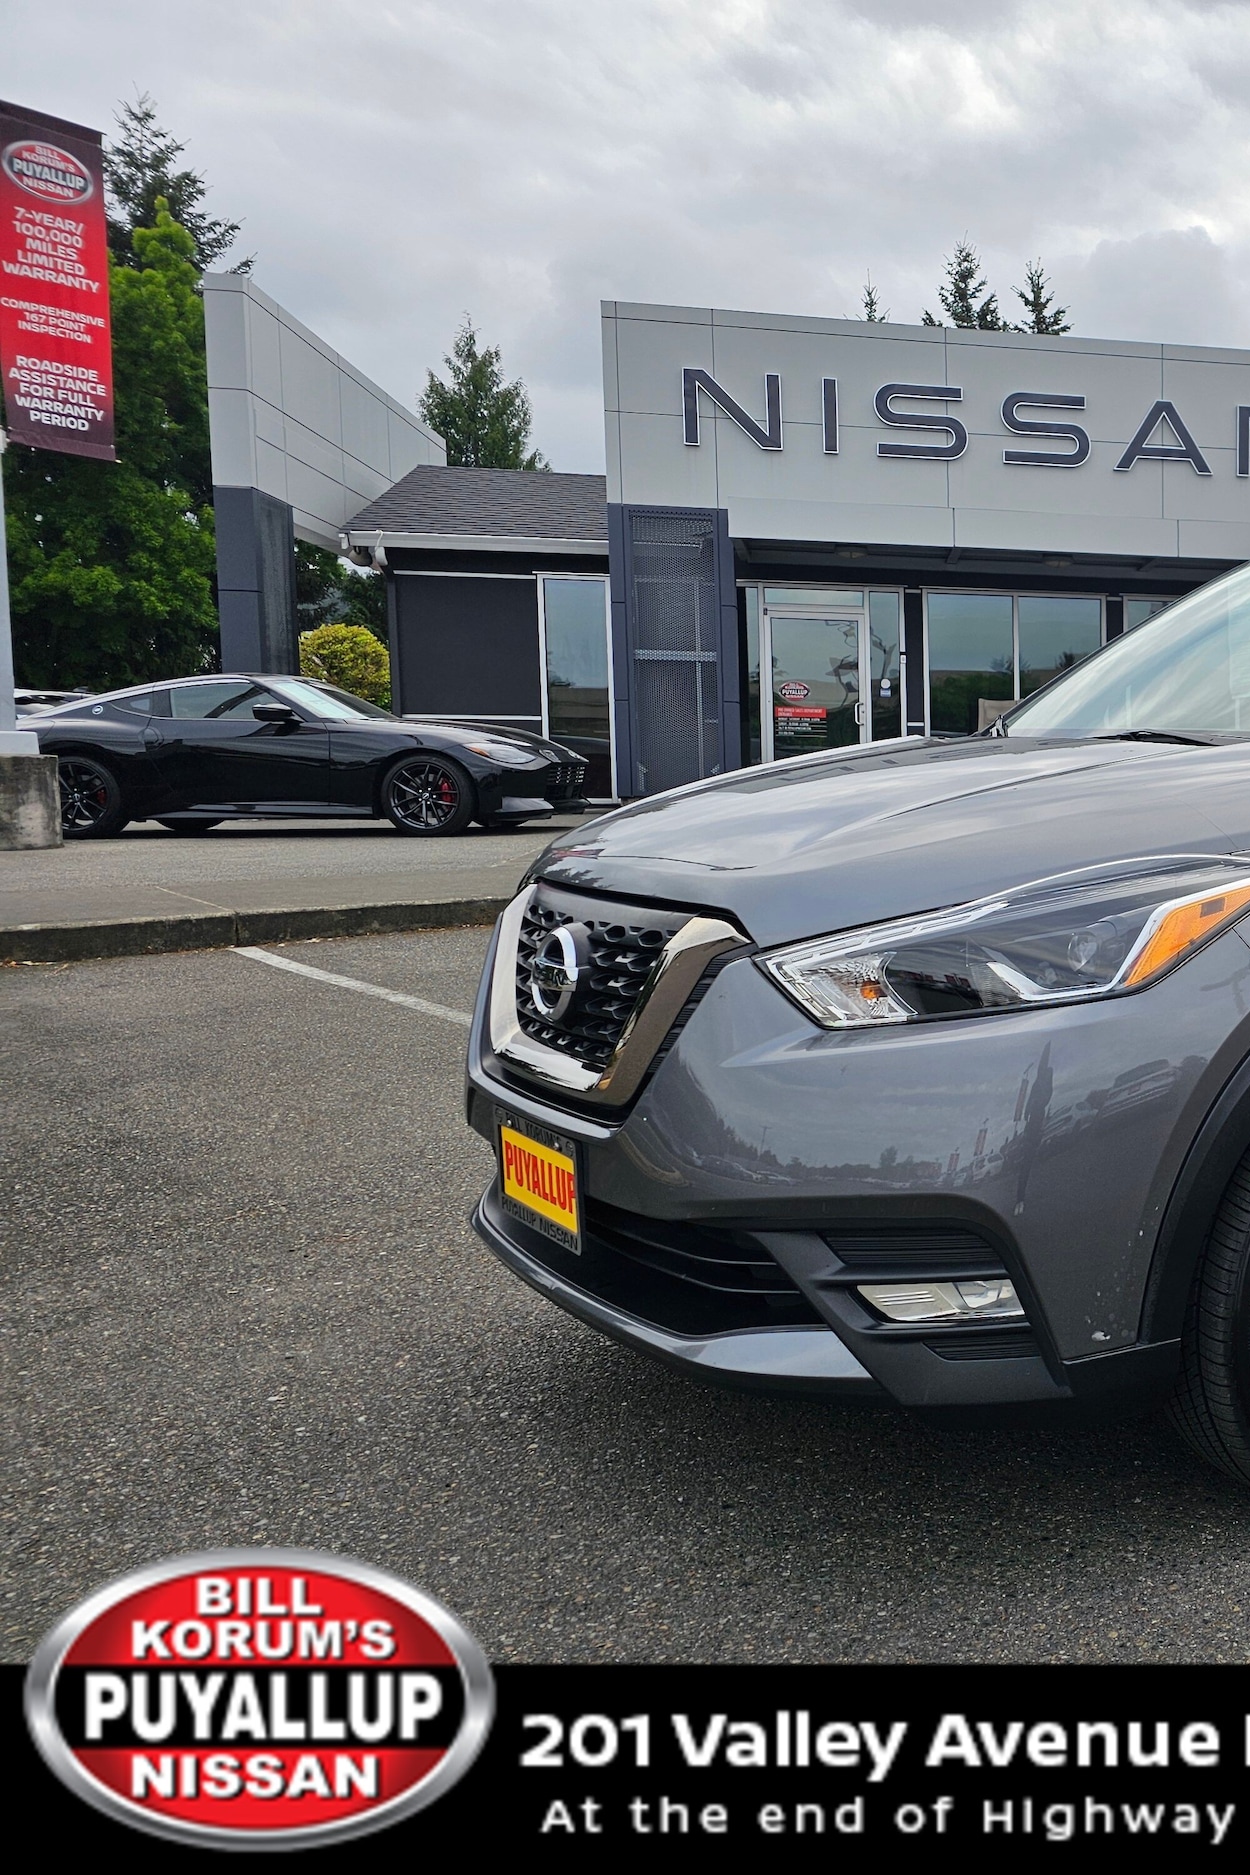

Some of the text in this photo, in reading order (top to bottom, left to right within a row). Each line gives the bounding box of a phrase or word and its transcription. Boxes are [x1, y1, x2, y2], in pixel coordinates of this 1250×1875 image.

[22, 151, 75, 171] KORUM'S
[35, 145, 61, 160] BILL
[13, 158, 85, 190] PUYALLUP
[23, 176, 74, 198] NISSAN
[14, 206, 84, 235] 7-YEAR/
[12, 221, 83, 248] 100,000
[26, 238, 78, 260] MILES
[2, 260, 100, 293] WARRANTY
[17, 250, 85, 276] LIMITED
[0, 297, 105, 328] COMPREHENSIVE
[24, 311, 86, 332] 167 POINT
[18, 320, 92, 344] INSPECTION
[9, 367, 106, 396] ASSISTANCE
[16, 354, 99, 382] ROADSIDE
[14, 394, 104, 421] WARRANTY
[20, 382, 95, 407] FOR FULL
[30, 410, 89, 431] PERIOD
[504, 1140, 576, 1214] PUYALLUP
[539, 1217, 578, 1251] NISSAN
